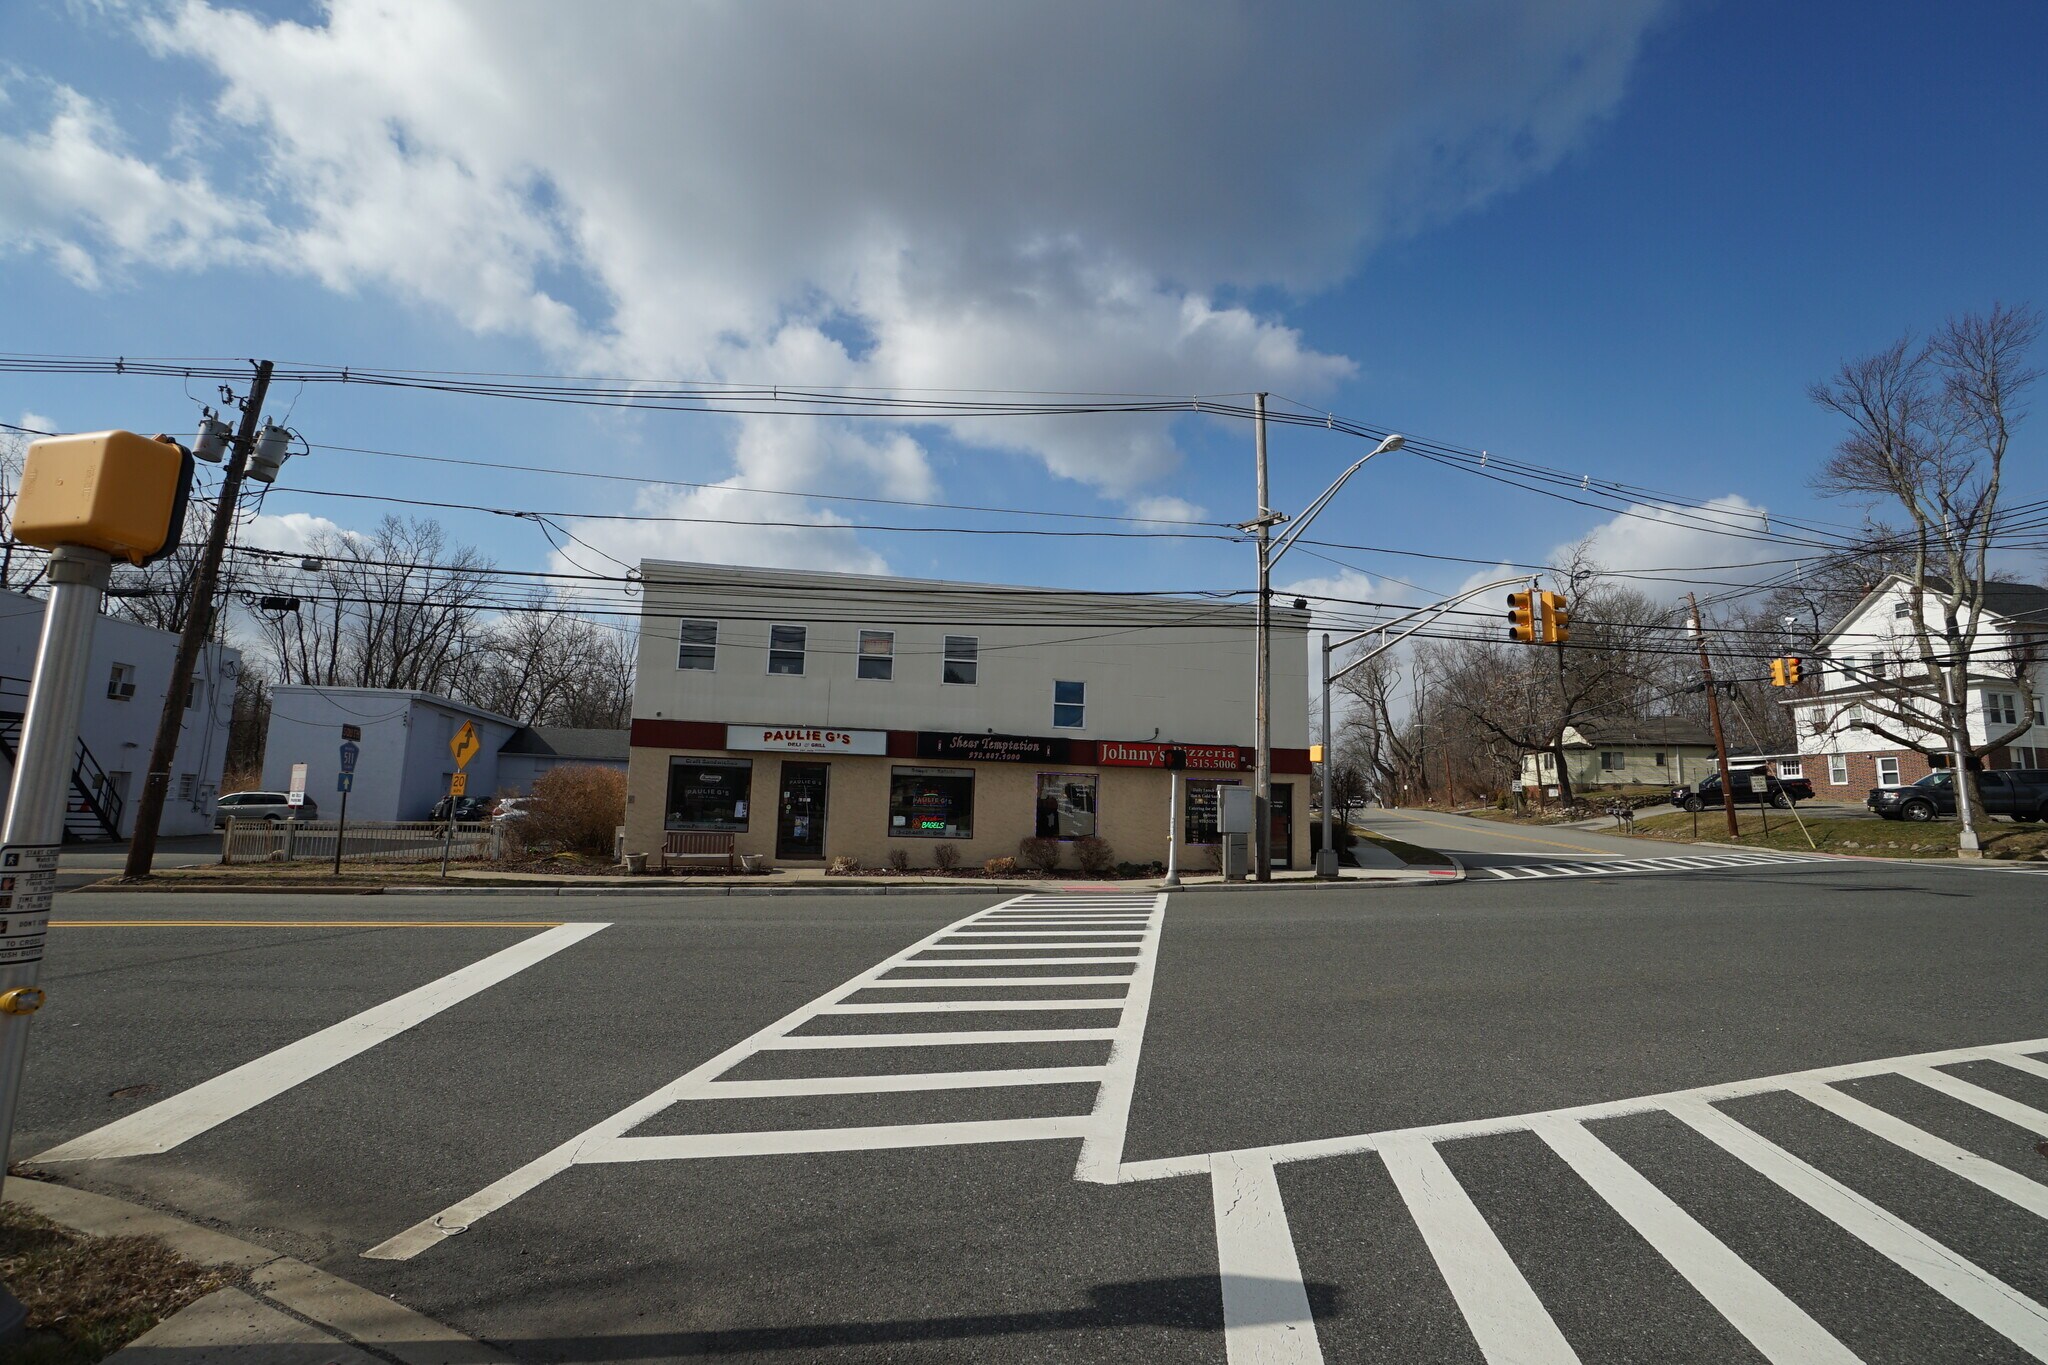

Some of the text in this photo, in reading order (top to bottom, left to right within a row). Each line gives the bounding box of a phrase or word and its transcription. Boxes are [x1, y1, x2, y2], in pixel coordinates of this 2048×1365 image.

[763, 730, 851, 745] PAULIE G'S
[949, 735, 1040, 754] Shear Temptation
[343, 751, 355, 764] 511
[1101, 743, 1166, 765] Johnny's
[453, 775, 465, 787] 20
[921, 821, 945, 829] BAGELS
[6, 937, 41, 948] TO CROSS
[0, 951, 17, 959] USH
